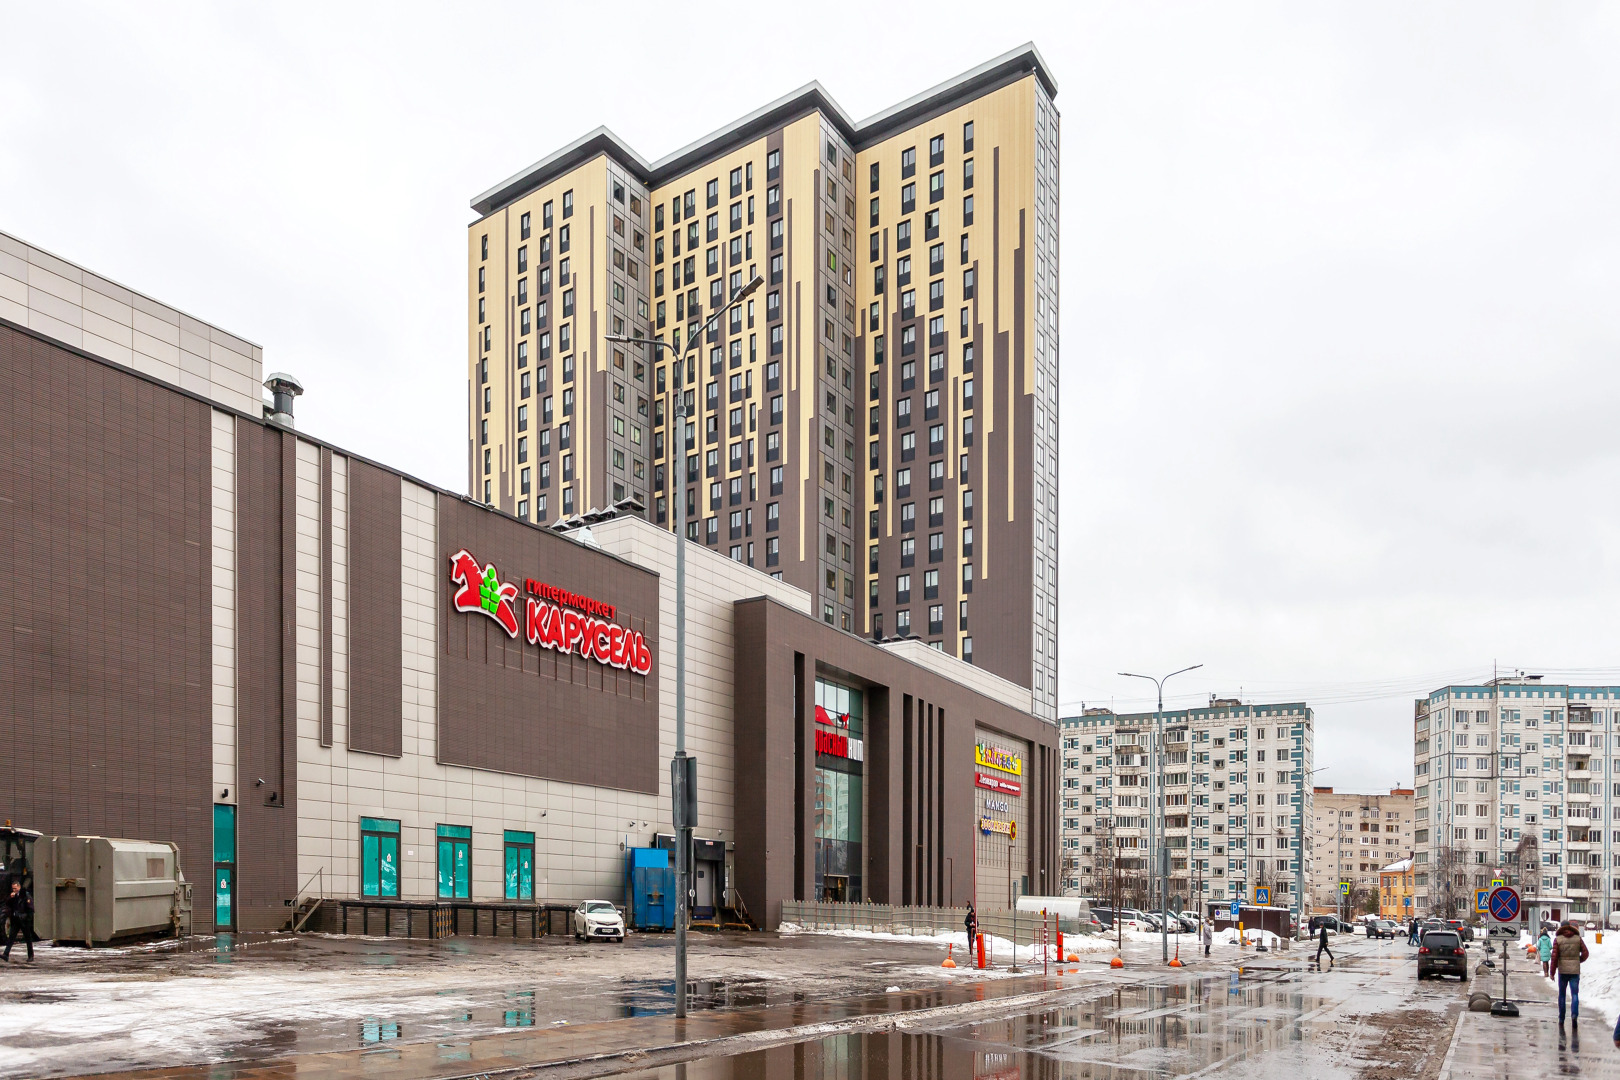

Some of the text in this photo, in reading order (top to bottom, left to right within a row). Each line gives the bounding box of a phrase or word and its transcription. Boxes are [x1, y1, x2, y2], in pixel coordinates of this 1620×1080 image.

[526, 578, 617, 619] гипермаркет
[526, 598, 652, 675] КАРУСЕЛЬ
[986, 799, 1008, 812] MANGO
